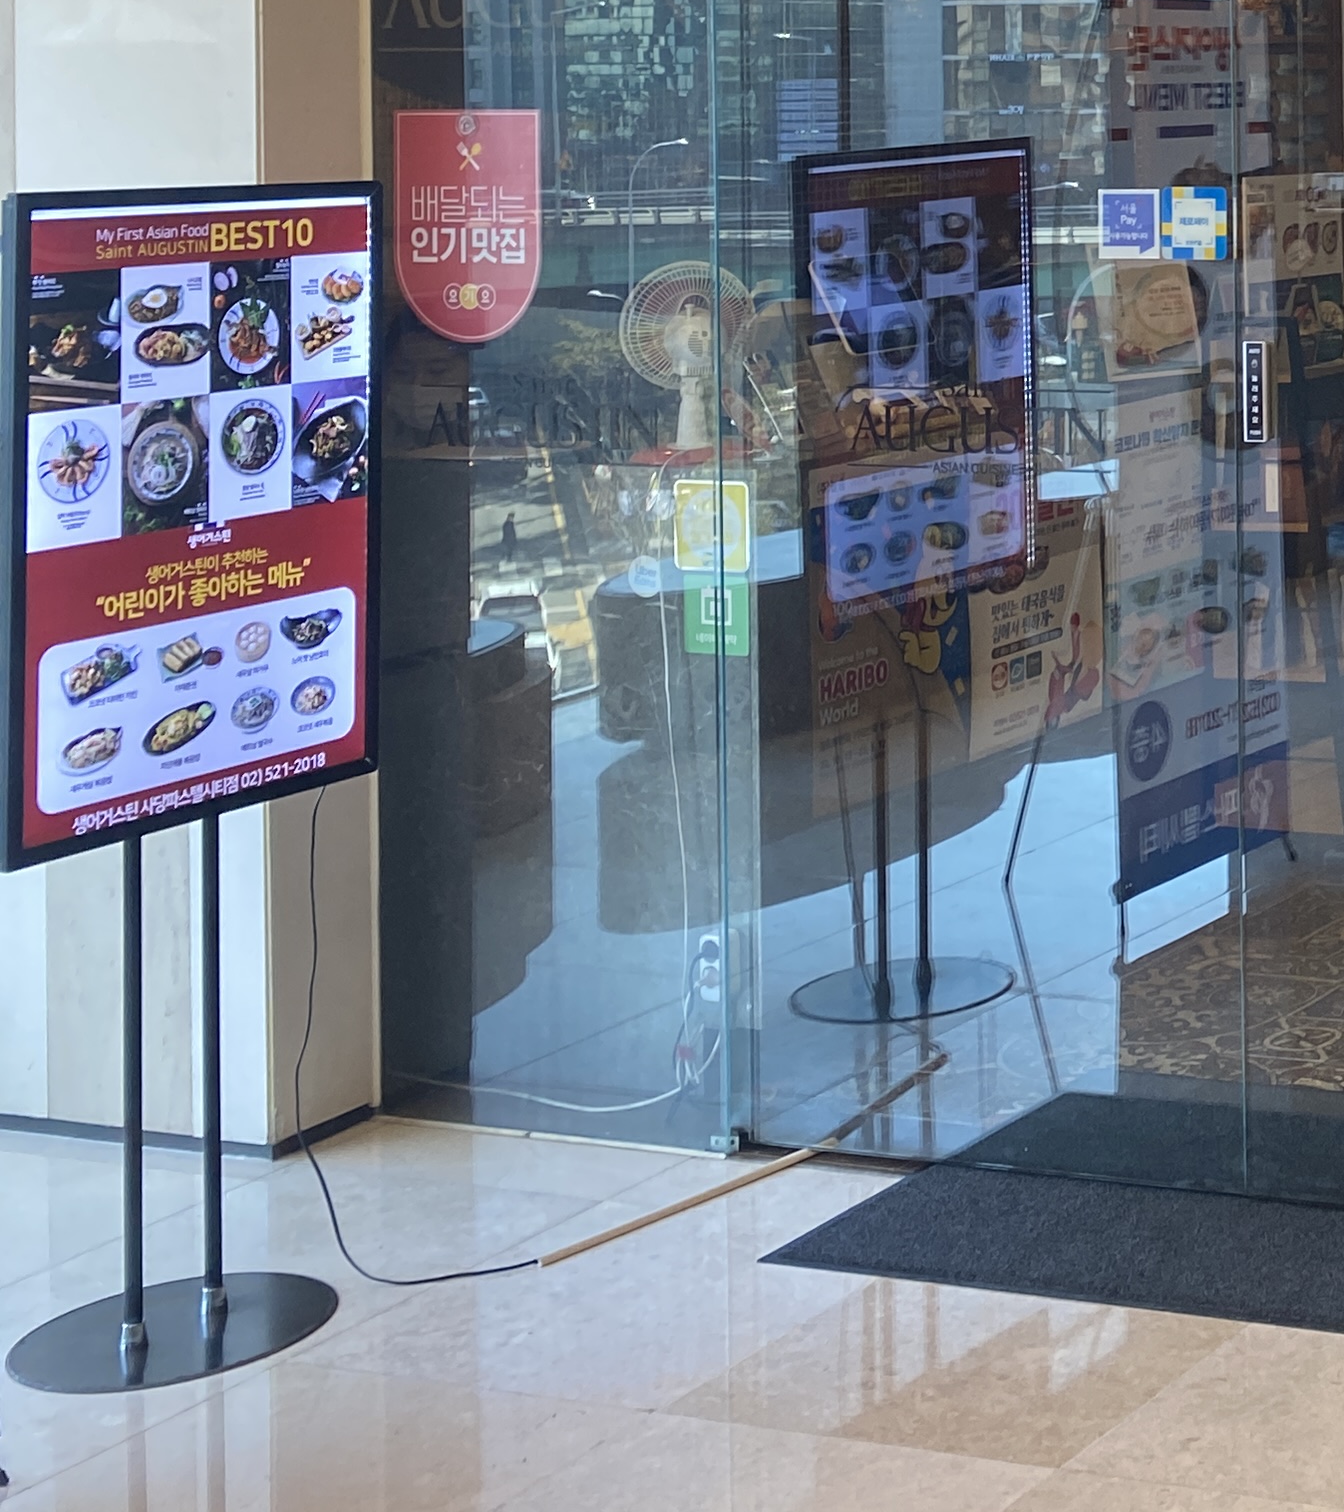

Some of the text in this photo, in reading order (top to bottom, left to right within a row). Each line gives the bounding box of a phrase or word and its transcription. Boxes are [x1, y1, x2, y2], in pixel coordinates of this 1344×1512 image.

[411, 185, 526, 223] 배달되는
[1119, 202, 1137, 215] 서울
[95, 223, 210, 244] My First Asian Food
[1120, 215, 1138, 227] Pay
[96, 239, 210, 260] Saint AUGUSTIN
[411, 227, 526, 264] 인기맛집
[446, 287, 493, 306] 요기요
[932, 461, 969, 475] ASIAN
[187, 528, 232, 549] 생어거스틴
[145, 546, 269, 584] 생어거스틴이 추천하는
[188, 569, 264, 607] 좋아하는
[818, 657, 890, 705] HARIBO
[819, 696, 859, 727] World
[72, 752, 326, 836] 생어거스틴 사당파스텔시티점 02) 521-2018
